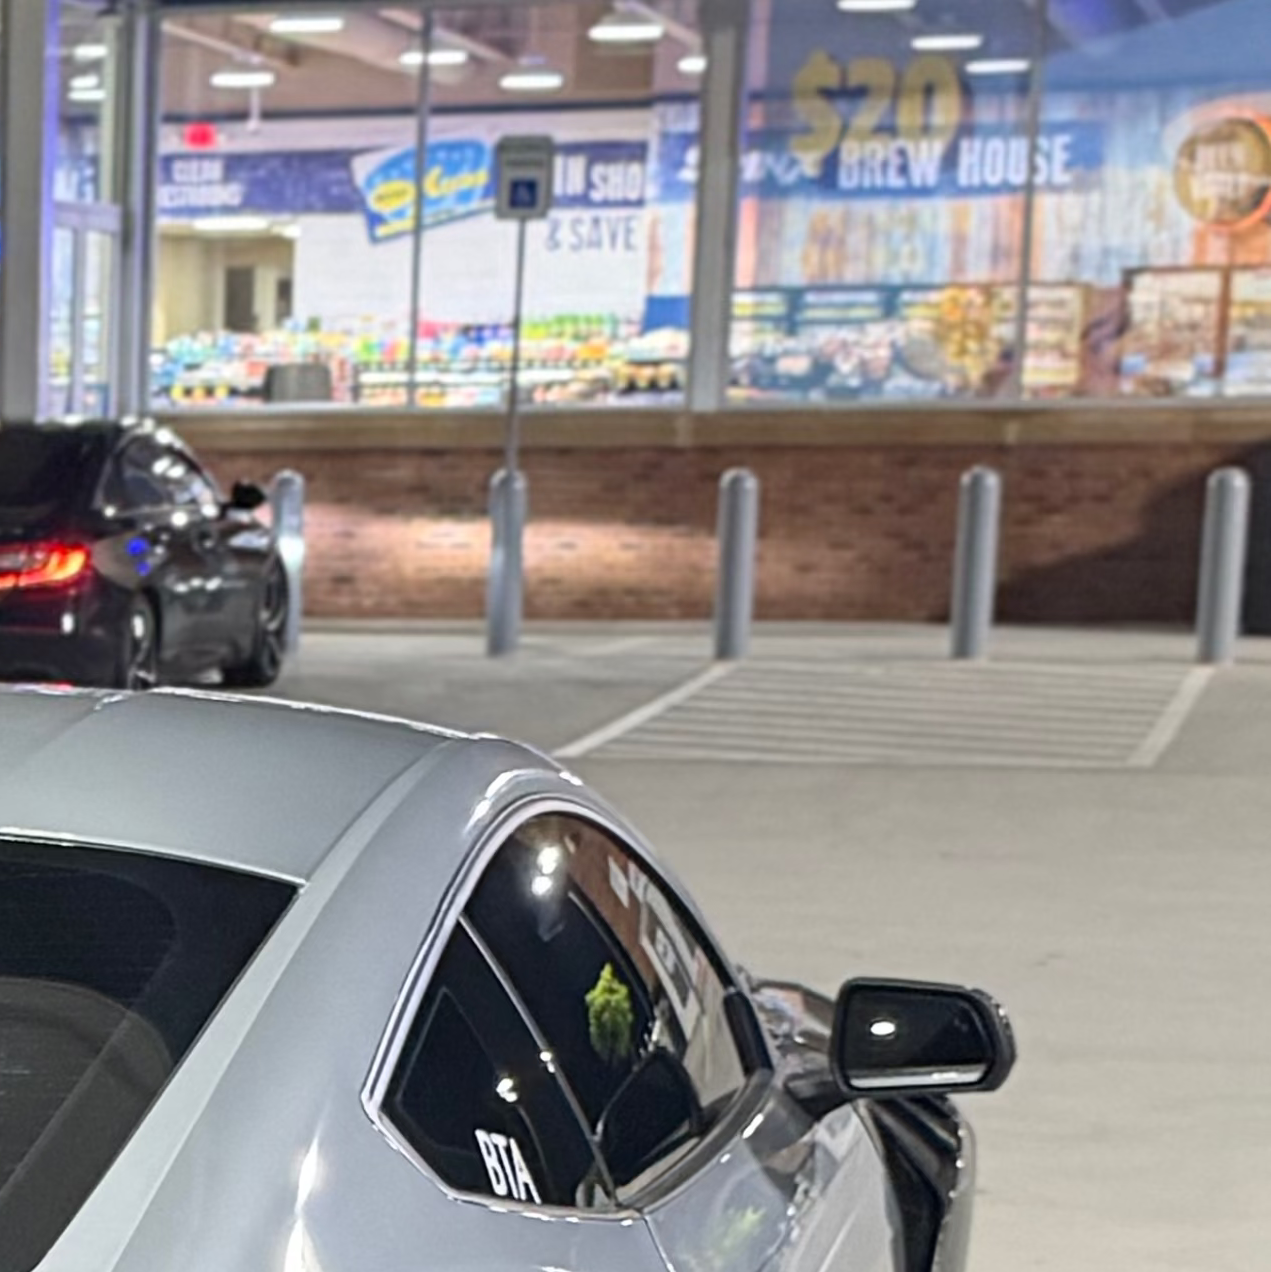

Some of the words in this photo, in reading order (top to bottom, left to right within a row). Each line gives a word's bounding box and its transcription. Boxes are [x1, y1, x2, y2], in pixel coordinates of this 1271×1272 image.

[790, 50, 962, 168] $20
[555, 155, 587, 196] IN
[837, 136, 946, 190] BREW
[958, 133, 1073, 187] HOUSE
[156, 182, 243, 208] ESTROOMS
[544, 217, 562, 251] &
[568, 214, 638, 251] SAVE
[474, 1128, 542, 1205] BTA
